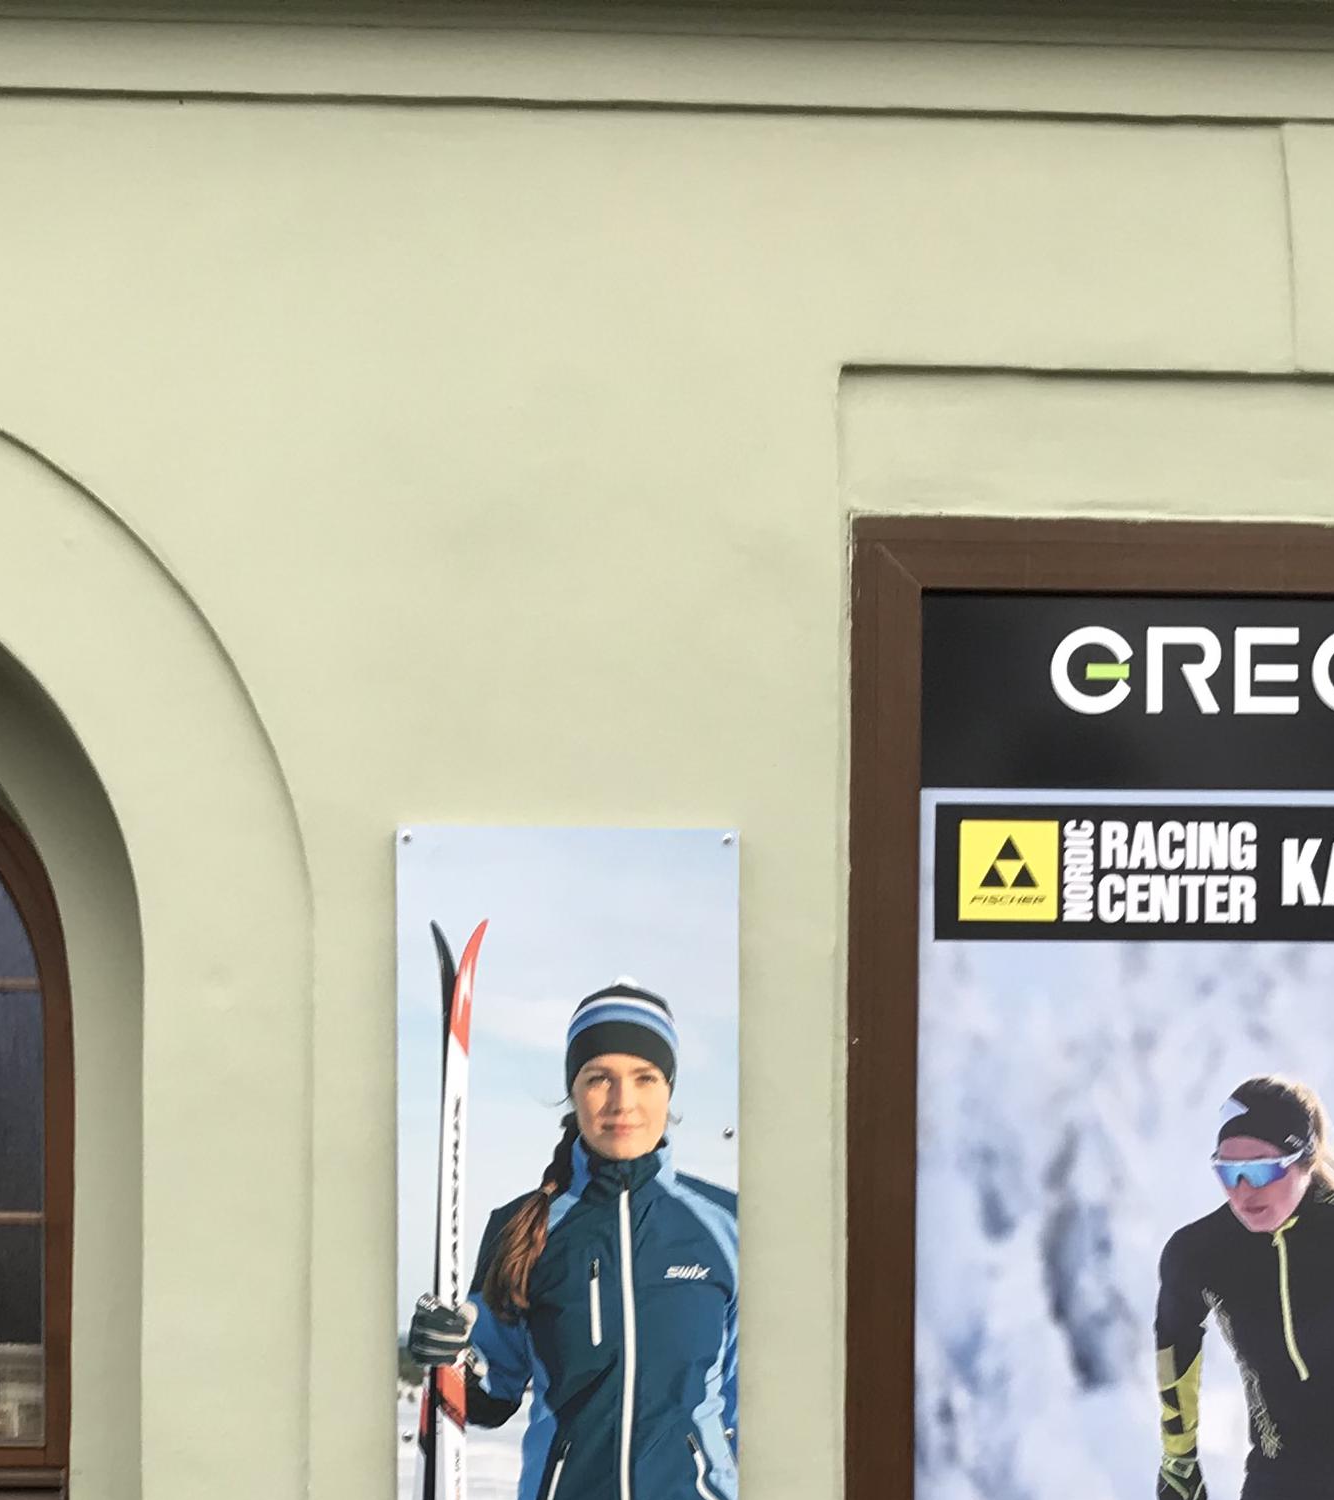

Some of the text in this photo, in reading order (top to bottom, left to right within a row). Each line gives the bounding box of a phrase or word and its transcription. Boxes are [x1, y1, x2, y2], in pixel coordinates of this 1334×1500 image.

[1062, 819, 1094, 922] NORDIC
[1099, 820, 1258, 871] RACING
[969, 894, 1047, 906] FISCHER
[1097, 873, 1258, 924] CENTER
